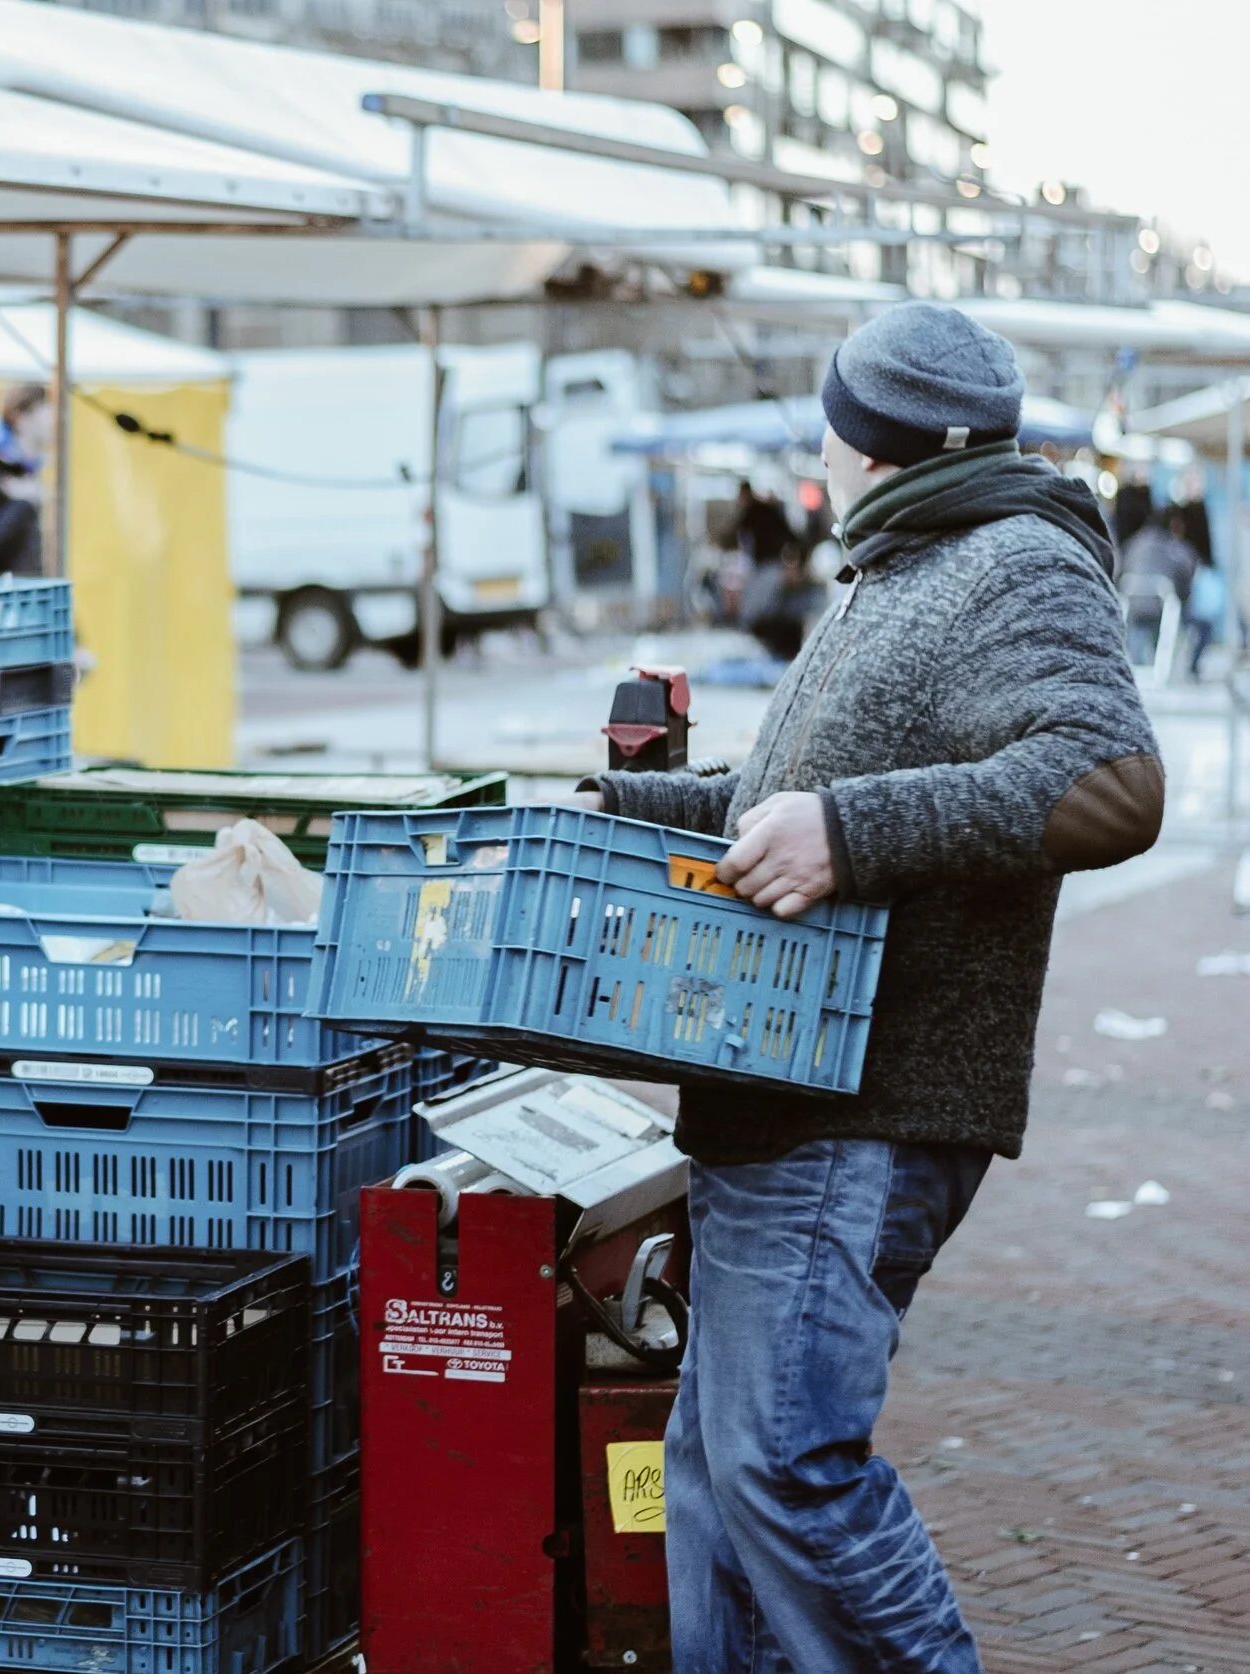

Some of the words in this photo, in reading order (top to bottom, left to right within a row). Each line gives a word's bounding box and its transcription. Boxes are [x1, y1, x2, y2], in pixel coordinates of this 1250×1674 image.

[385, 1299, 488, 1328] SALTRANS
[448, 1328, 469, 1336] intern
[471, 1330, 503, 1339] transport
[473, 1350, 501, 1359] SERVICE
[464, 1360, 505, 1371] TOYOTA
